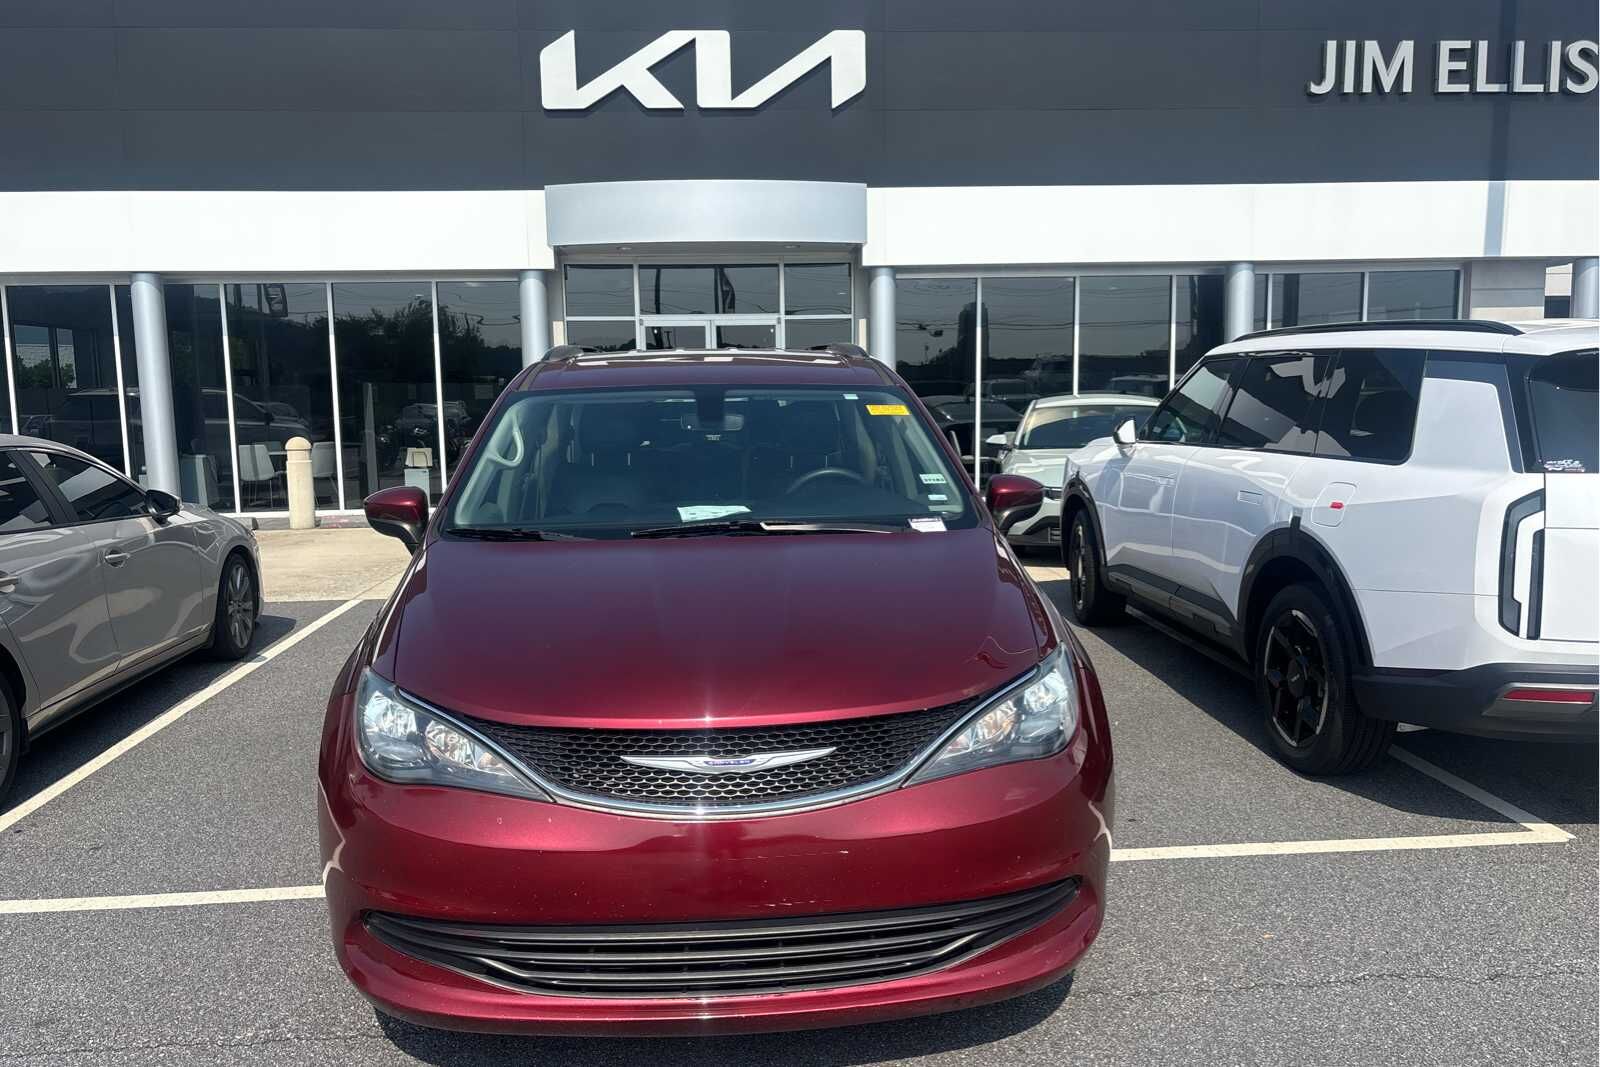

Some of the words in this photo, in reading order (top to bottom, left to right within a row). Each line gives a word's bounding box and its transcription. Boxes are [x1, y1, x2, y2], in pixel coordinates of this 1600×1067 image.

[540, 29, 866, 109] KIA
[1309, 40, 1414, 94] JIM
[1436, 40, 1599, 94] ELLIS
